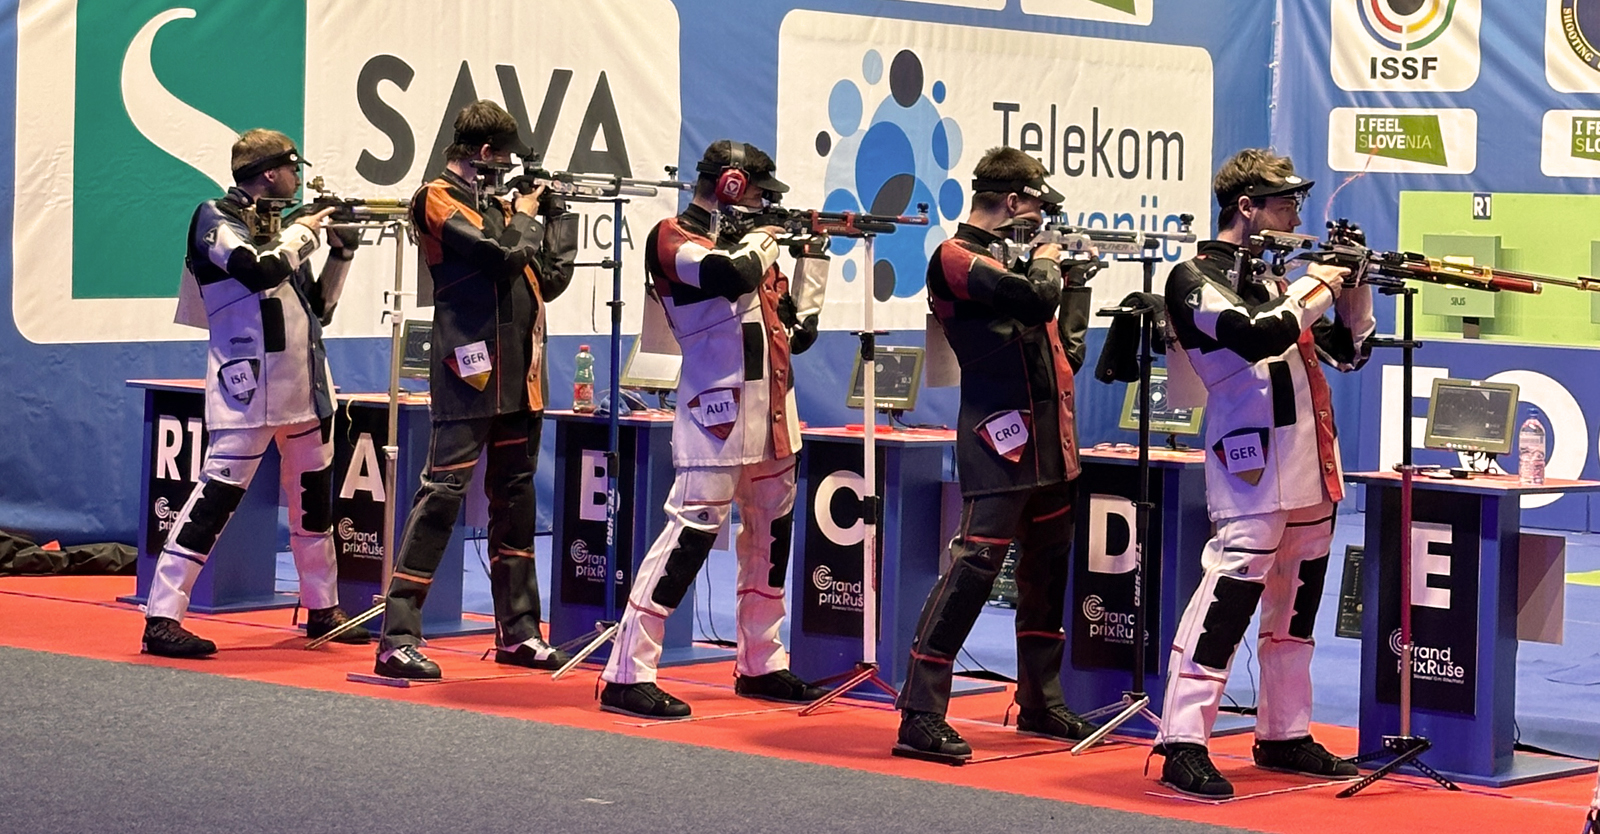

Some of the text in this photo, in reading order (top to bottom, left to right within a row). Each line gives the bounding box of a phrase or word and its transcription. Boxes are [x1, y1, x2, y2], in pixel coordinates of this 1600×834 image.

[1563, 8, 1594, 62] SHOOTING
[1370, 57, 1438, 80] ISSF
[355, 54, 633, 187] SAVA
[1359, 118, 1403, 132] I FEEL
[1575, 121, 1600, 136] I FE
[993, 101, 1184, 181] Telekom
[1359, 134, 1432, 149] SLOVENIA
[1473, 196, 1491, 217] R1
[462, 352, 486, 366] GER
[230, 372, 248, 385] ISR
[706, 401, 730, 415] AUT
[995, 423, 1021, 442] CRO
[156, 414, 203, 483] R1
[1229, 446, 1258, 461] GER
[339, 432, 386, 502] A
[579, 449, 621, 522] B
[154, 496, 181, 519] Gra
[814, 469, 865, 546] C
[1088, 493, 1137, 574] D
[570, 539, 607, 565] Gran
[575, 564, 624, 580] prixRe
[1410, 520, 1453, 609] E
[818, 592, 864, 608] prixRuš
[1089, 621, 1135, 639] prixRu
